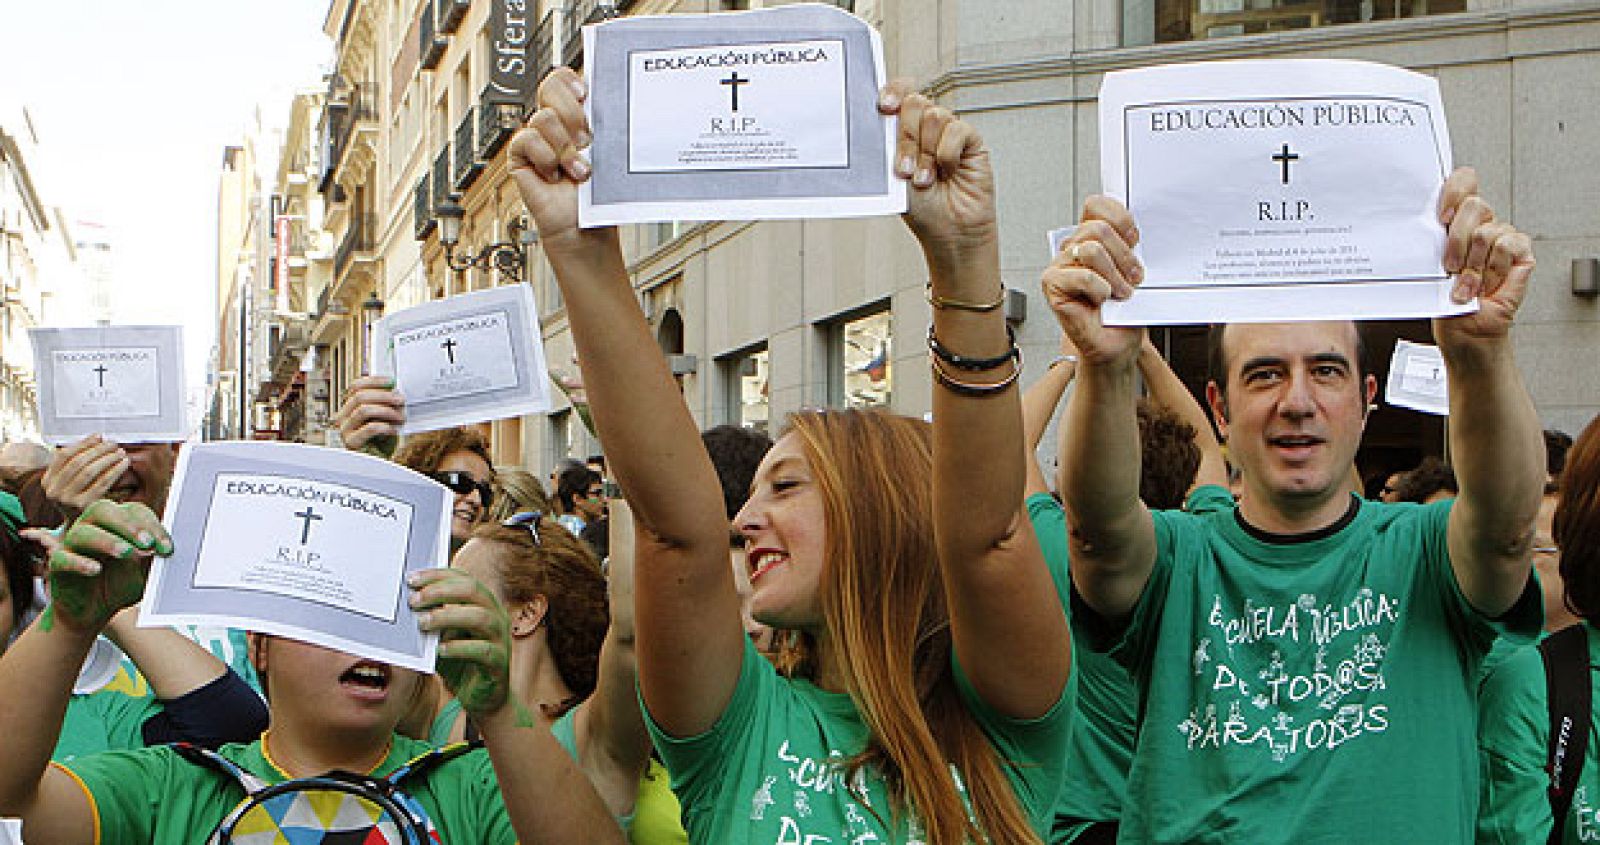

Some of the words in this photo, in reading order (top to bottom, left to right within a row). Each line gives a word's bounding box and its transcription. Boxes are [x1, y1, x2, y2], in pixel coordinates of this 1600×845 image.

[643, 51, 748, 72] EDUCACIÓN
[752, 48, 828, 65] PÚBLICA
[711, 117, 761, 134] R.I.P.
[1150, 104, 1304, 132] EDUCACIÓN
[1313, 102, 1417, 127] PÚBLICA
[1257, 200, 1315, 222] R.I.P.
[226, 481, 326, 503] EDUCACIÓN
[328, 491, 398, 521] PÚBLICA
